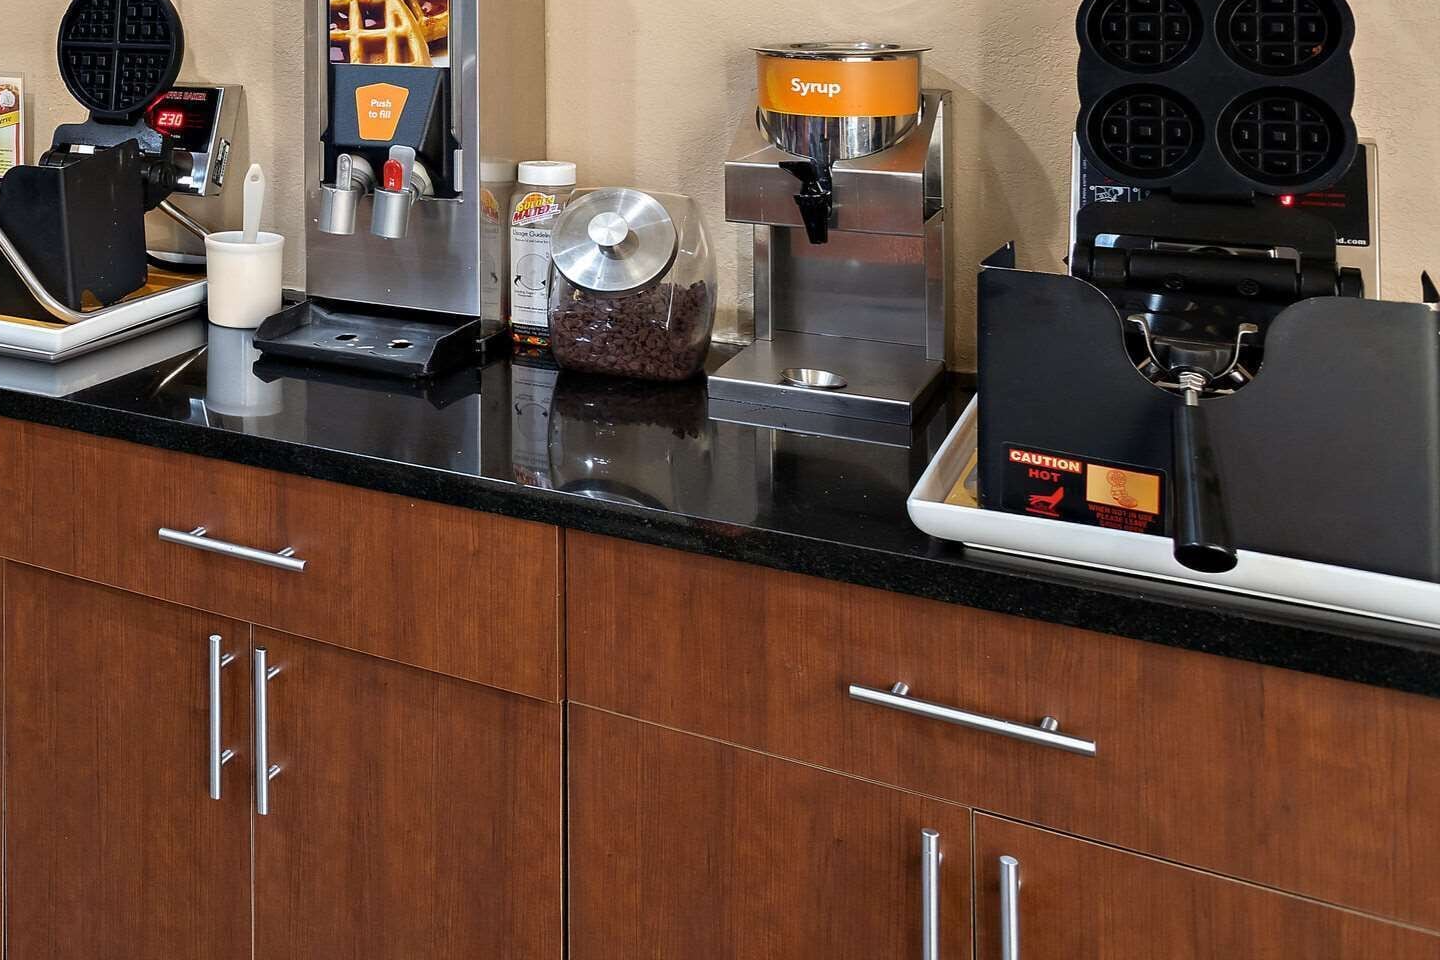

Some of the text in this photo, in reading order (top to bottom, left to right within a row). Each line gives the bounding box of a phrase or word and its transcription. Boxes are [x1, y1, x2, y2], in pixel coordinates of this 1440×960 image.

[791, 78, 841, 97] Syrup
[370, 99, 392, 108] Push
[159, 112, 183, 127] 230
[368, 110, 391, 119] to fill
[513, 204, 550, 222] MALTED
[1010, 450, 1081, 472] CAUTION
[1028, 469, 1062, 482] HOT
